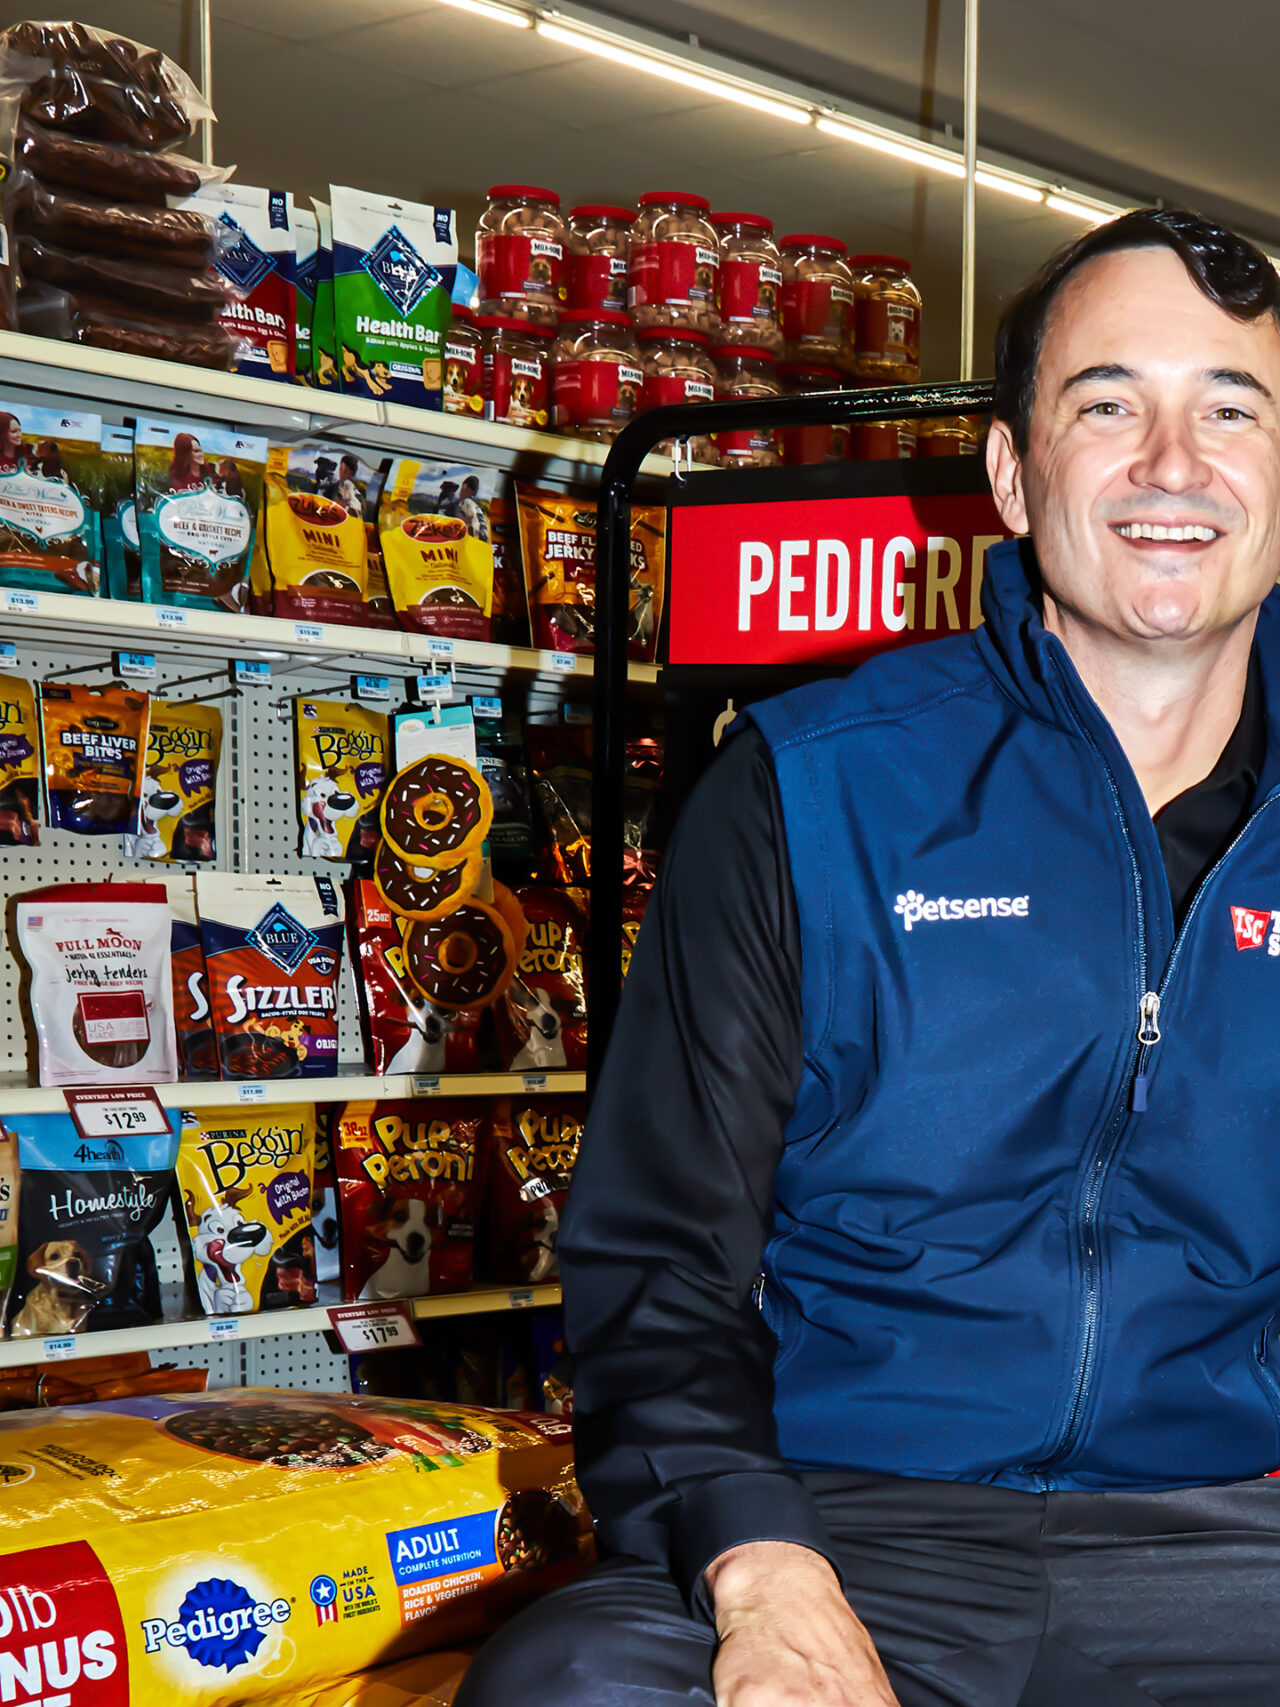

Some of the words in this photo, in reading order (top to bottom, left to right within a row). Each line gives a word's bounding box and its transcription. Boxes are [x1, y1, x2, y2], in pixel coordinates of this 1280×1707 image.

[272, 198, 283, 206] NO
[437, 214, 448, 222] NO
[356, 315, 413, 335] Health
[415, 323, 441, 344] Bar
[17, 502, 36, 512] SWEET
[174, 521, 189, 530] BEEF
[224, 527, 242, 538] RECIPE
[303, 529, 341, 548] MINI
[548, 531, 578, 543] BEEF
[420, 548, 459, 565] MINI
[546, 544, 594, 560] JERKY
[738, 536, 1005, 632] PEDIGRE
[62, 732, 99, 746] BEEF
[101, 736, 137, 751] LIVER
[902, 893, 1029, 931] petsense
[1234, 908, 1263, 944] TSC
[55, 941, 94, 952] FULL
[96, 937, 142, 950] MOON
[266, 932, 299, 944] BLUE
[65, 964, 100, 987] jerky
[104, 965, 148, 980] tenders
[226, 975, 338, 1023] SIZZLER
[88, 1021, 114, 1032] USA
[89, 1031, 115, 1039] MADE
[210, 1130, 247, 1139] PURINA
[363, 1144, 476, 1191] Peroni
[508, 1144, 577, 1180] Pero
[275, 1176, 300, 1194] Original
[49, 1183, 157, 1222] Homestyle
[274, 1196, 290, 1208] With
[396, 1528, 461, 1563] ADULT
[343, 1566, 368, 1578] MADE
[399, 1559, 440, 1576] COMPLETE
[441, 1550, 482, 1565] NUTRITION
[343, 1584, 375, 1602] USA
[402, 1582, 441, 1598] ROASTED
[443, 1571, 484, 1588] CHICKEN,
[404, 1597, 425, 1609] RICE
[427, 1595, 433, 1605] &
[435, 1583, 478, 1602] VEGETABLE
[142, 1599, 290, 1654] Pedigree
[0, 1630, 117, 1699] NUS
